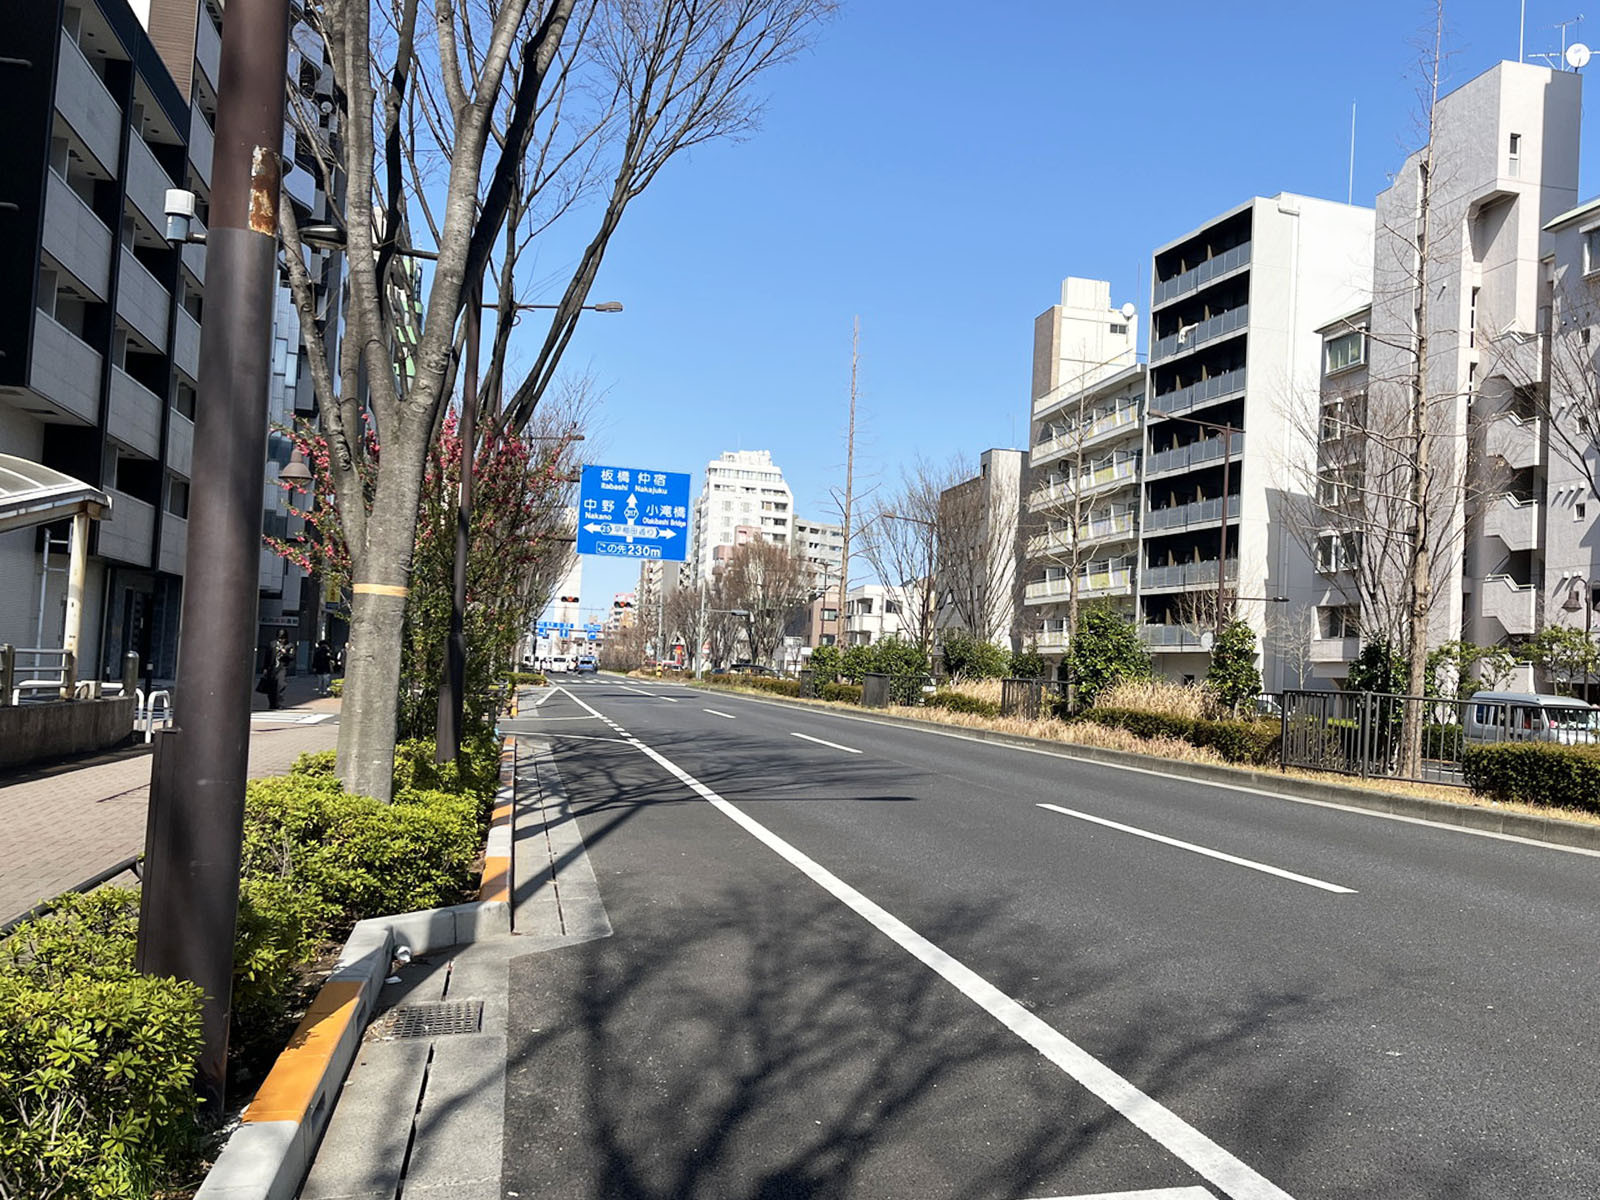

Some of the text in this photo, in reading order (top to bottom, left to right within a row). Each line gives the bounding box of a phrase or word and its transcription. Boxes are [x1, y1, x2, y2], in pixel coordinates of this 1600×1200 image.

[601, 469, 666, 487] 板橋 仲宿
[635, 485, 667, 494] Nakajuku
[584, 499, 614, 512] 中野
[646, 504, 685, 518] 小滝橋
[585, 512, 612, 520] Nakano
[670, 519, 686, 527] Bridge
